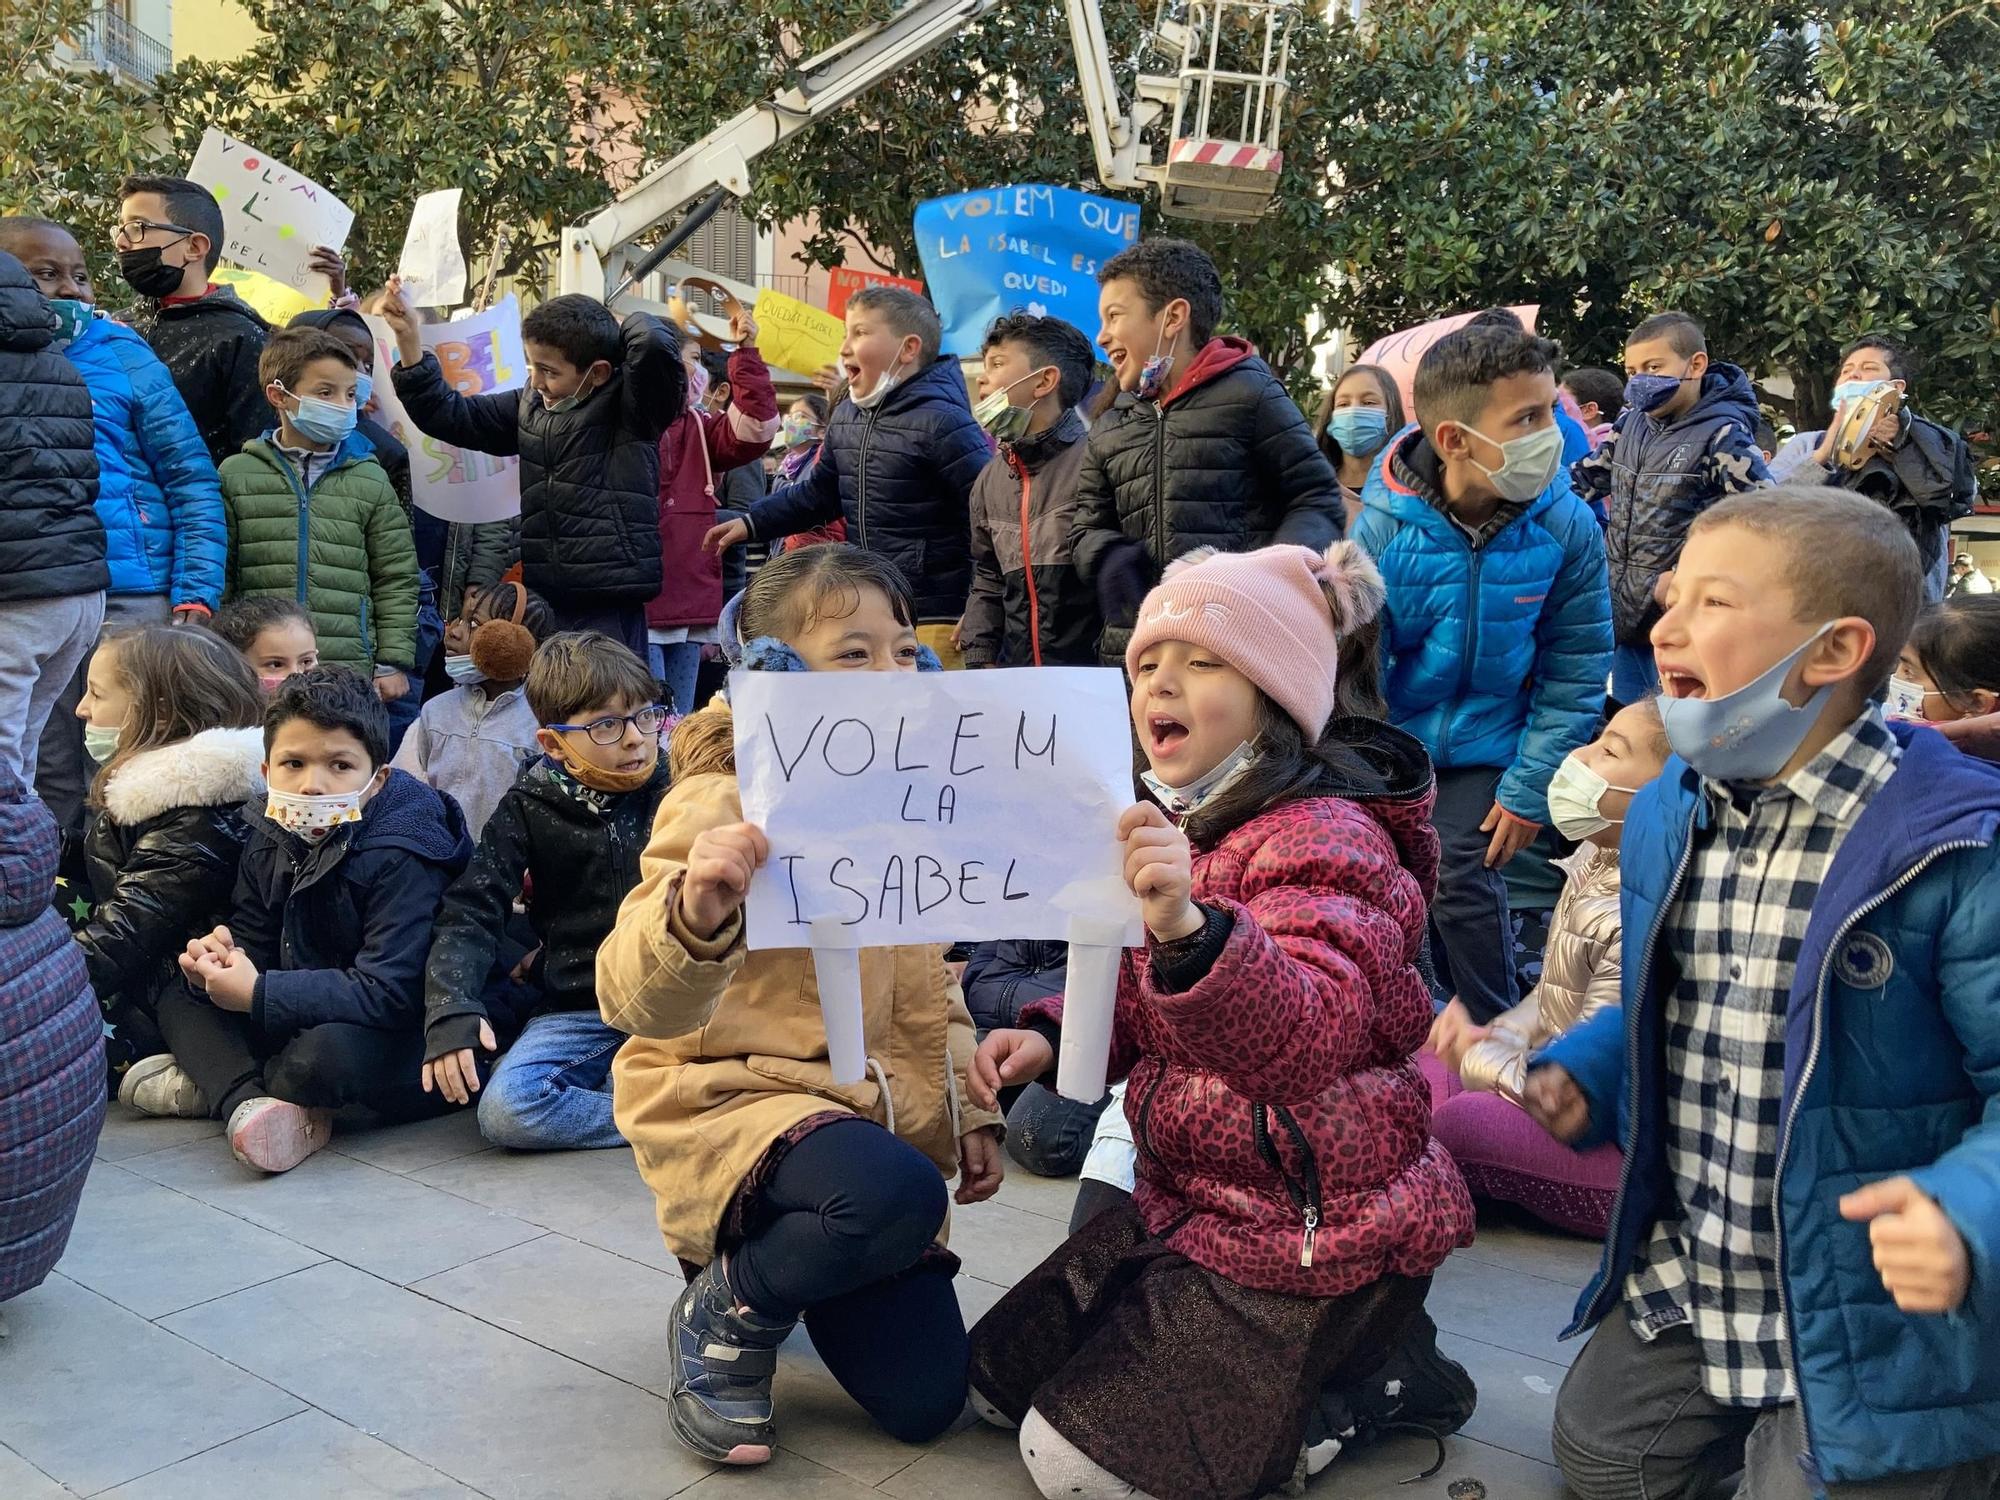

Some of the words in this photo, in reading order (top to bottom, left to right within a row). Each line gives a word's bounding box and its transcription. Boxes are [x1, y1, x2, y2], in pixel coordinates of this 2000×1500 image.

[222, 137, 317, 203] VOLEM
[941, 187, 1055, 221] VOLEM
[1080, 201, 1137, 240] QUE
[940, 234, 972, 258] LA
[988, 233, 1056, 265] ISABEL
[1072, 254, 1096, 275] ES
[1003, 272, 1067, 297] QUEDI
[765, 710, 1056, 782] VOLEM
[901, 784, 956, 824] LA
[779, 854, 1030, 925] ISABEL
